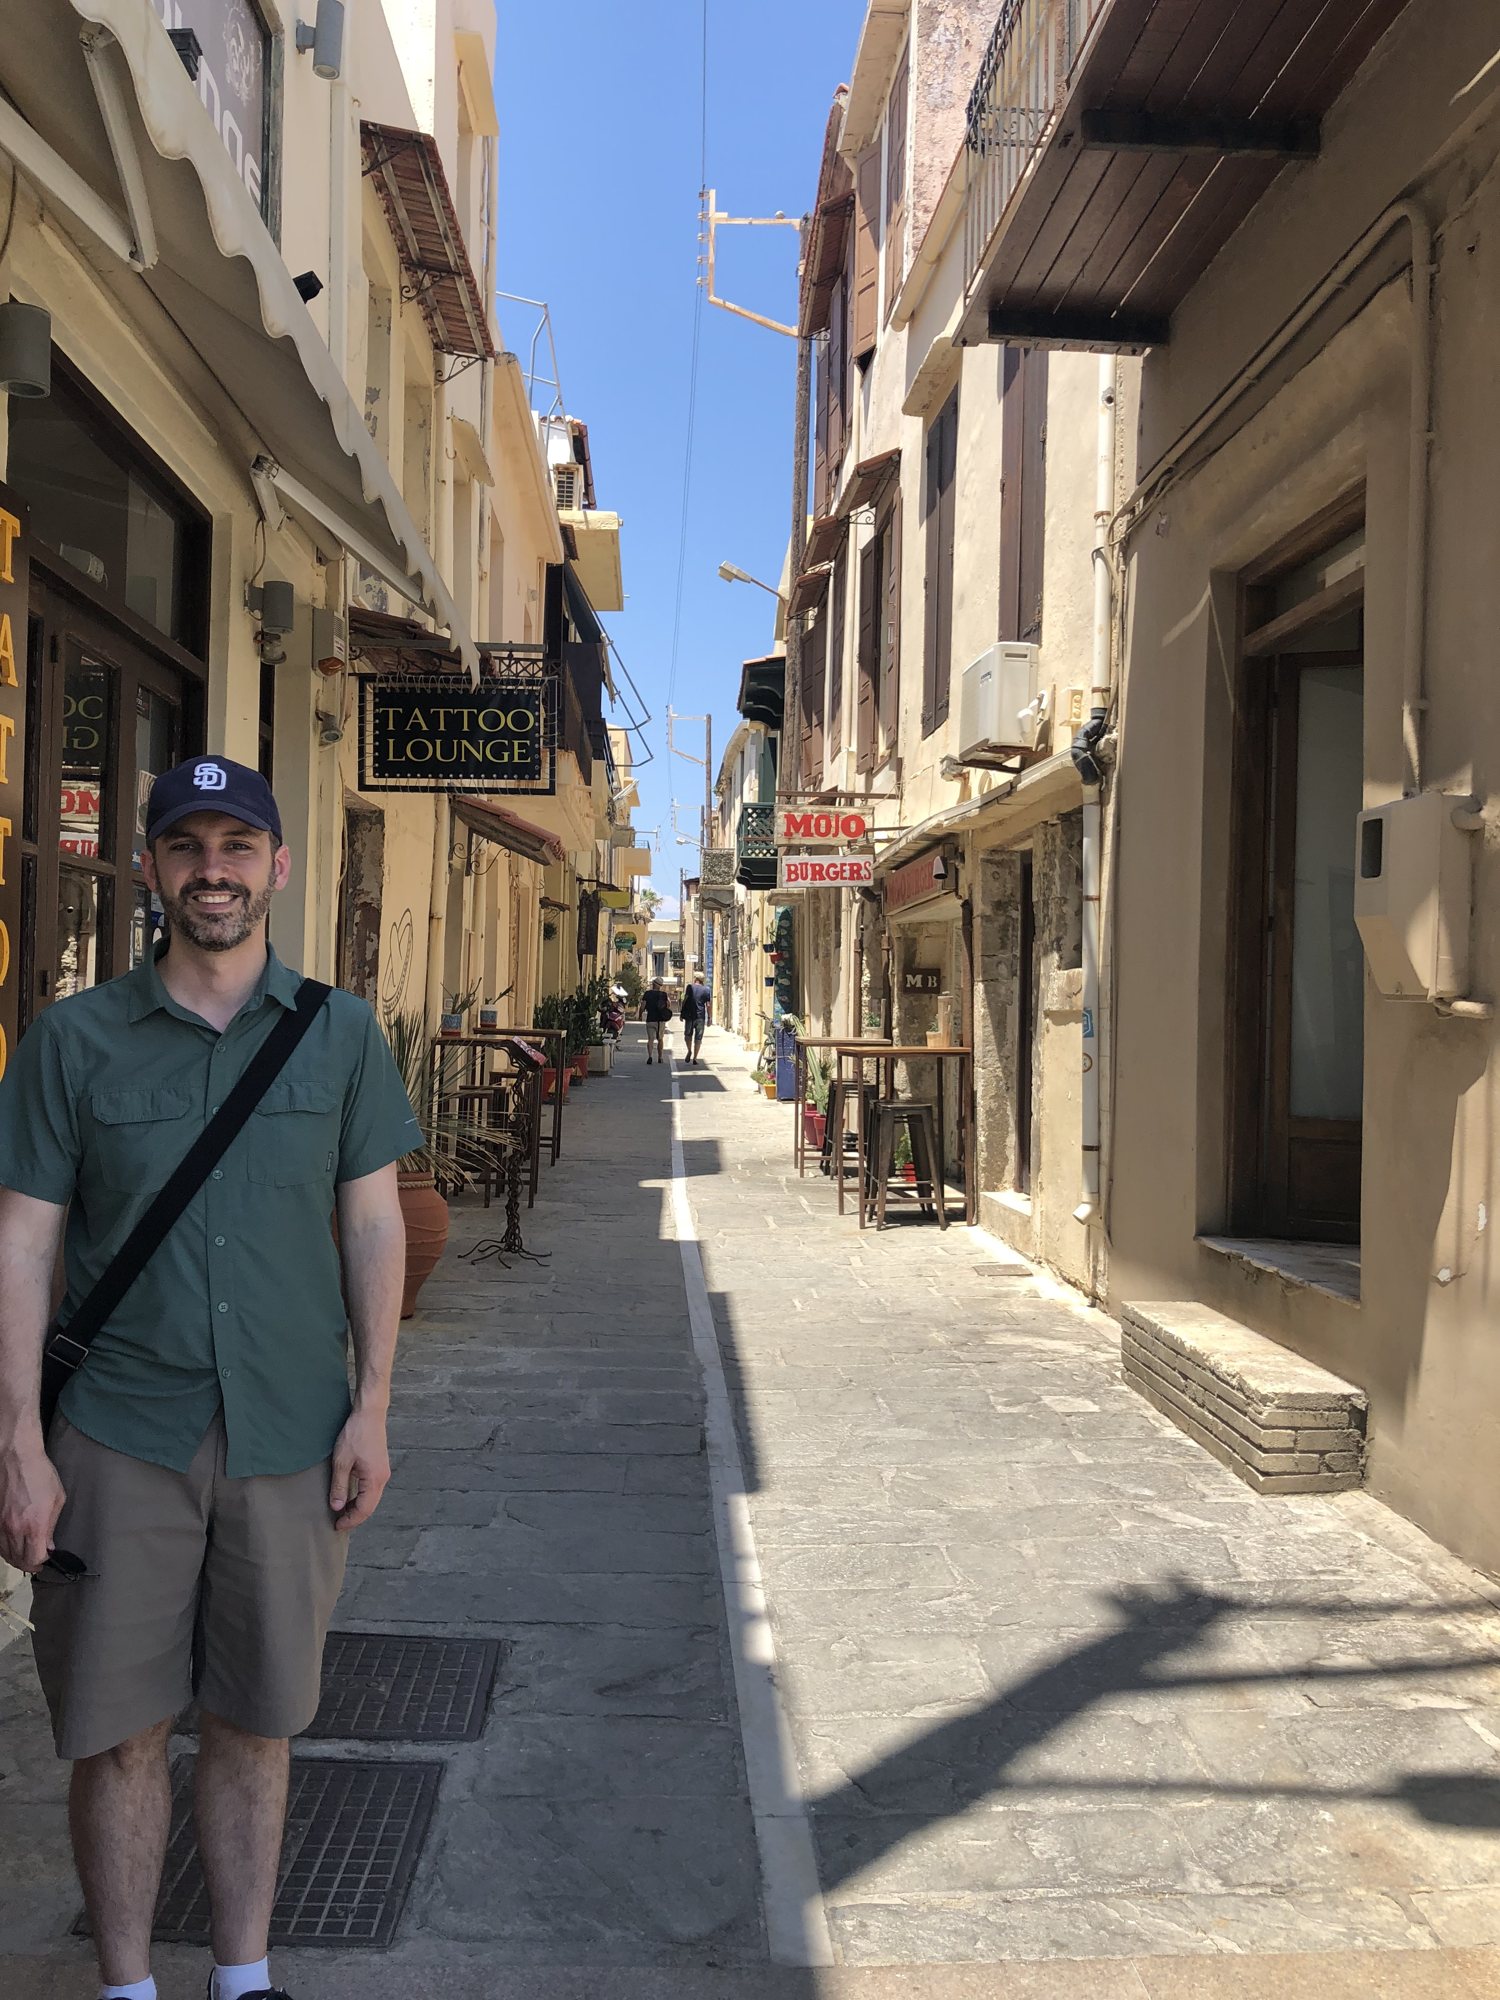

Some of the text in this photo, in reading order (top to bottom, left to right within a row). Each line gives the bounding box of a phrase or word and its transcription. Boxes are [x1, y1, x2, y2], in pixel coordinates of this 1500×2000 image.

[379, 707, 535, 732] TATTOO
[387, 738, 531, 763] LOUNGE
[193, 763, 227, 791] SD
[0, 505, 21, 1084] TATT
[783, 813, 866, 838] MOJO
[785, 860, 872, 883] BURGERS
[906, 974, 938, 988] M B
